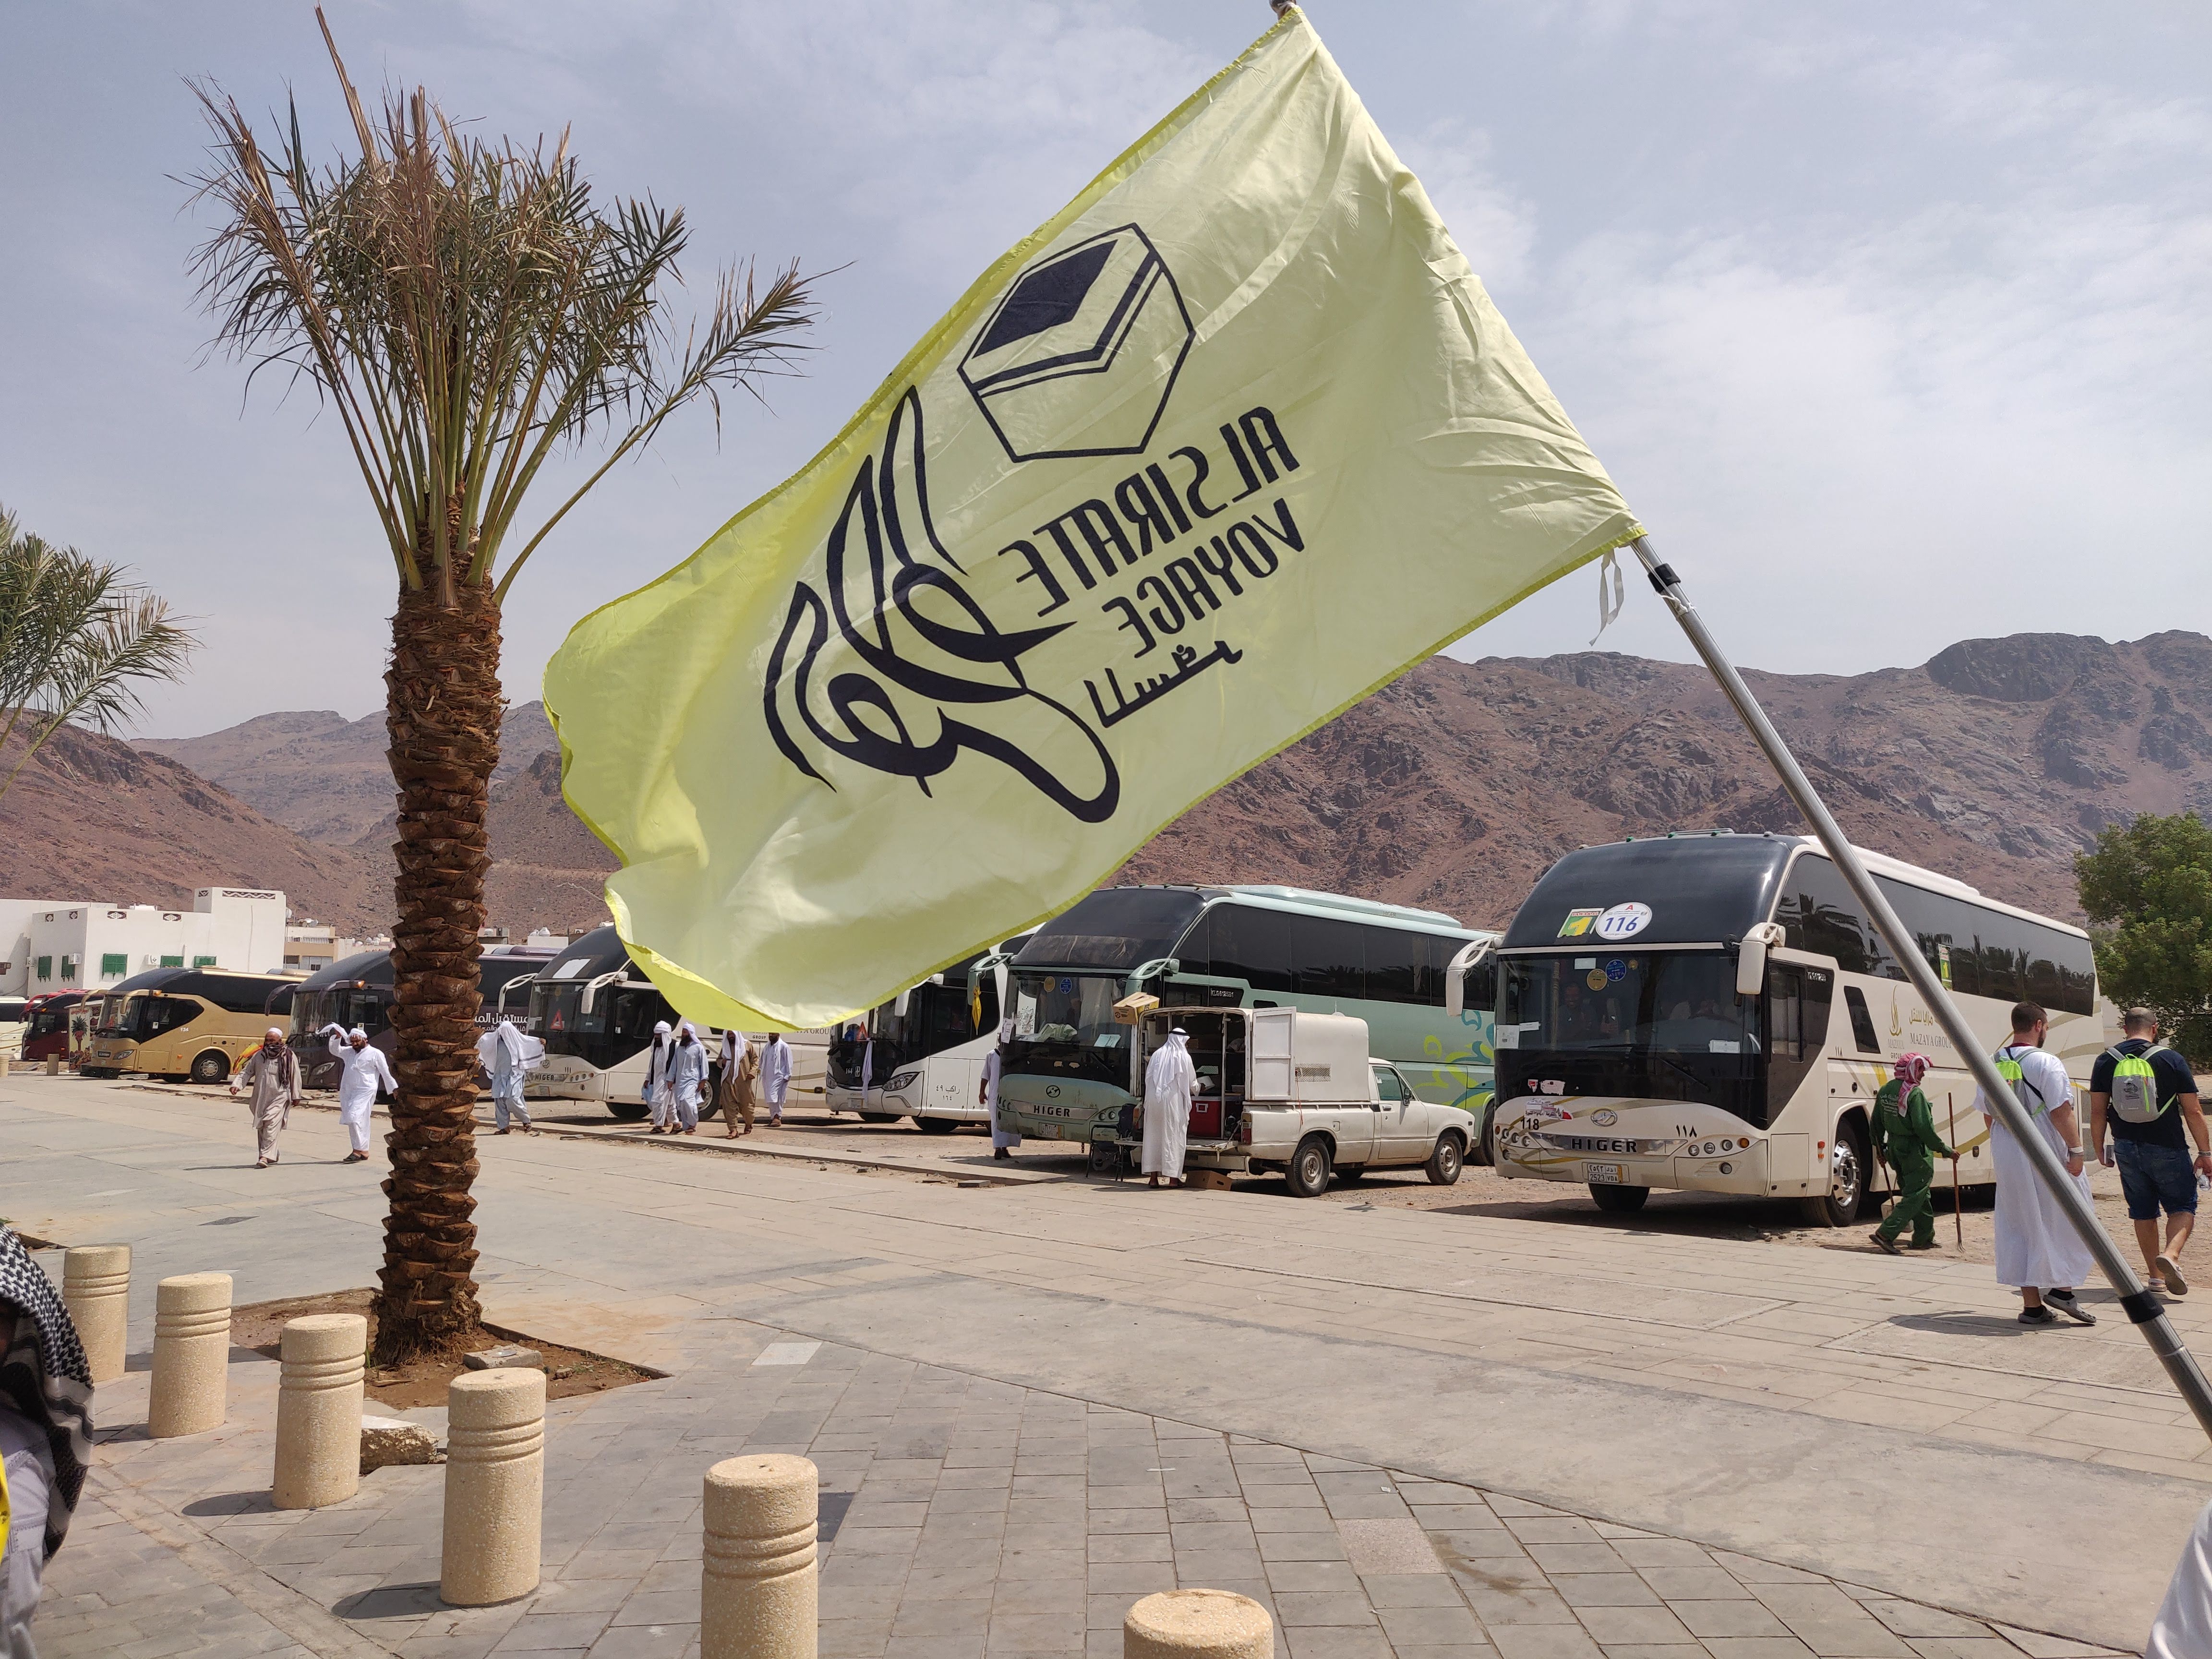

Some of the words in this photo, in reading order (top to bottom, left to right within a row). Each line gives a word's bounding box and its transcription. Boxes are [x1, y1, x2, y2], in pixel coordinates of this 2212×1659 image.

[1604, 916, 1639, 932] 116
[1911, 1033, 1934, 1046] MAZAYA
[946, 1085, 960, 1094] راكب
[1034, 1105, 1070, 1117] HIGER
[1521, 1118, 1539, 1130] 118
[1676, 1125, 1697, 1137] ١١٨
[1572, 1138, 1637, 1152] HIGER
